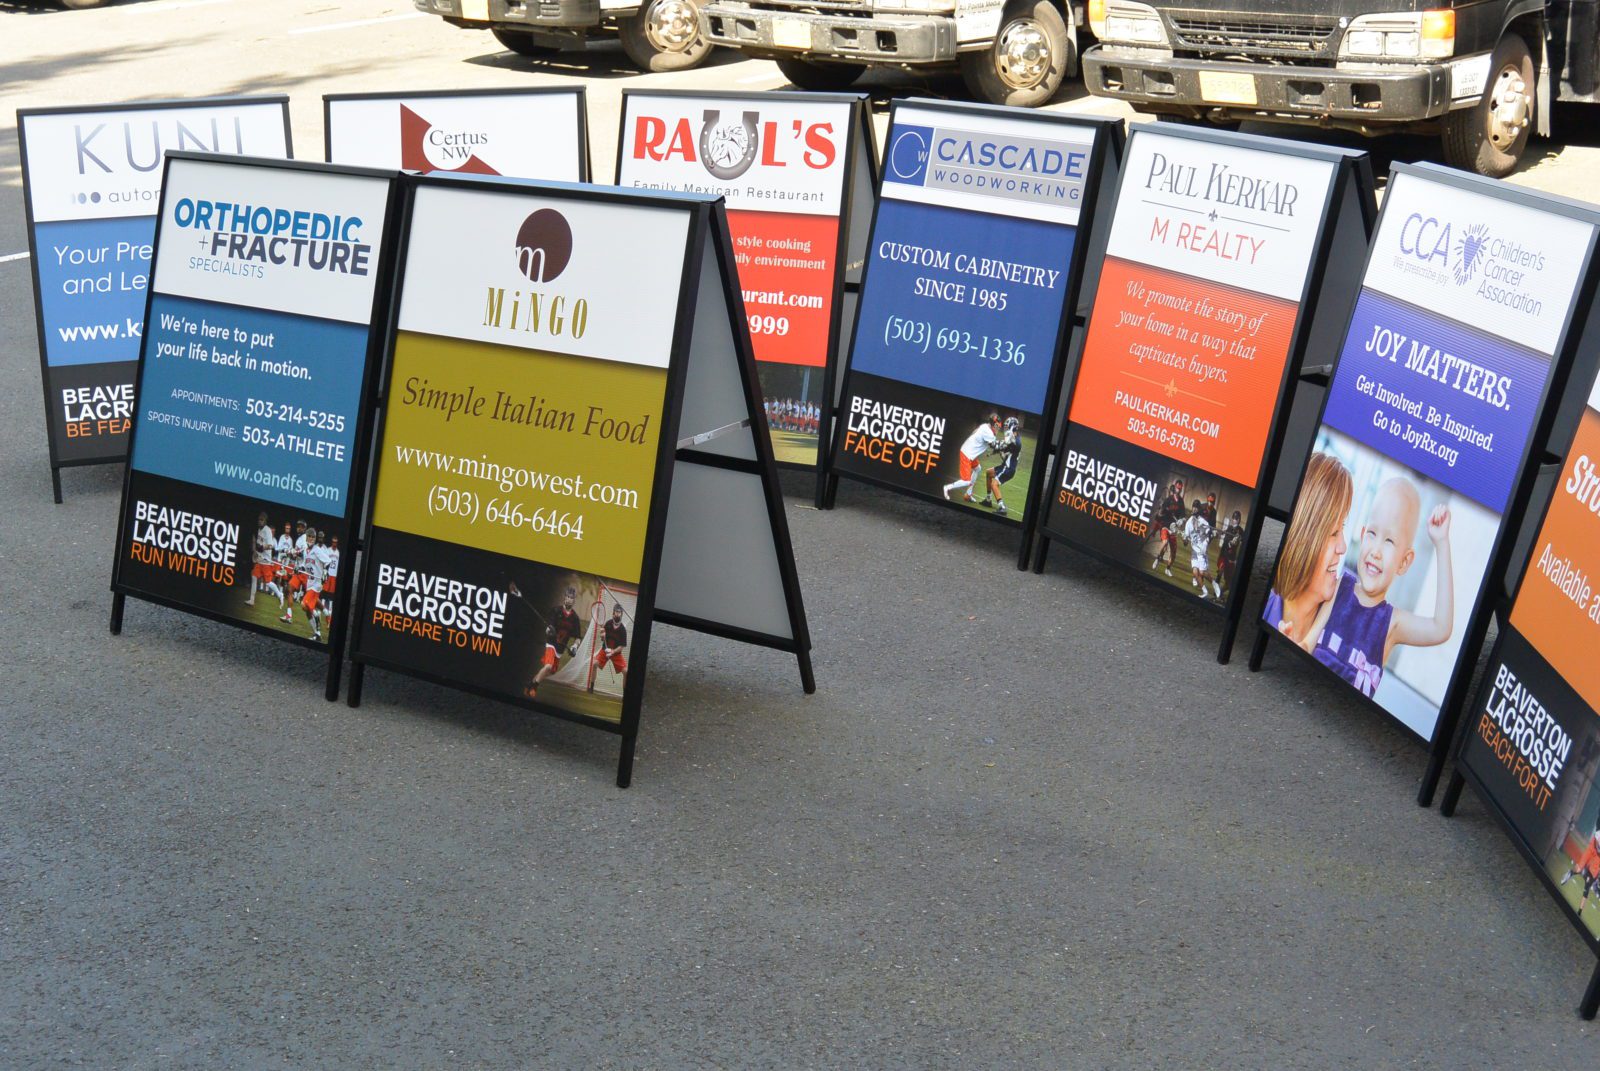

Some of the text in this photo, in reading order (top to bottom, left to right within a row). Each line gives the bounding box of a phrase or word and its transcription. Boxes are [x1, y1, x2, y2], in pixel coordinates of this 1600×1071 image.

[74, 116, 243, 174] KUNI
[430, 130, 487, 146] Certus
[442, 147, 471, 160] NW
[938, 138, 1085, 179] CASCADE
[684, 184, 739, 196] Mexican
[747, 187, 823, 202] Restaurant
[934, 170, 1079, 199] WOODWORKING
[174, 198, 363, 242] ORTHOPEDIC
[1151, 217, 1266, 264] M REALTY
[1400, 212, 1451, 267] CCA
[54, 242, 153, 265] Your Pre
[737, 236, 762, 248] style
[766, 239, 811, 253] cooking
[755, 255, 825, 270] environment
[879, 241, 1060, 288] CUSTOM CABINETRY
[1491, 238, 1545, 271] Children's
[63, 272, 150, 294] and Le
[189, 257, 264, 278] SPECIALISTS
[1484, 259, 1525, 287] Cancer
[914, 278, 1007, 310] SINCE 1985
[1127, 280, 1268, 336] We promote the story of
[1476, 279, 1542, 316] Association
[59, 318, 143, 342] www.k
[161, 313, 274, 349] We're here to put
[747, 314, 789, 336] 999
[885, 315, 1026, 365] (503) 693-1336
[1116, 311, 1256, 360] your home in a way that
[156, 343, 311, 380] your life back in motion.
[1130, 342, 1227, 383] captivates buyers.
[1365, 325, 1511, 410] JOY MATTERS.
[62, 384, 134, 404] BEAVE
[64, 401, 134, 422] LACR
[171, 389, 345, 432] APPOINTMENTS: 503-214-5255
[403, 377, 650, 445] Simple Italian Food
[851, 396, 946, 434] BEAVERTON
[1115, 391, 1220, 438] PAULKERKAR.COM
[1356, 375, 1494, 452] Get Involved. Be Inspired.
[66, 422, 91, 437] BE
[148, 411, 345, 462] SPORTS INJURY LINE: 503-ATHLETE
[848, 413, 942, 454] LACROSSE
[1128, 418, 1195, 453] 503-516-5783
[1373, 410, 1459, 467] Go to JoyRx.org
[844, 431, 939, 474] FACE OFF
[214, 461, 339, 501] www.oandfs.com
[395, 446, 638, 508] www.mingowest.com
[1062, 468, 1153, 523] LACROSSE
[1067, 450, 1157, 501] BEAVERTON
[1566, 455, 1600, 517] Stro
[135, 501, 239, 544] BEAVERTON
[429, 485, 583, 541] (503) 646-6464
[1059, 490, 1147, 538] STICK TOGETHER
[131, 542, 234, 586] RUN WITH US
[133, 521, 237, 566] LACROSSE
[378, 564, 507, 613] BEAVERTON
[1537, 543, 1590, 610] Available
[373, 610, 501, 657] PREPARE TO WIN
[375, 586, 504, 638] LACROSSE
[1495, 663, 1572, 762] BEAVERTON
[1486, 687, 1563, 790] LACROSSE
[1478, 714, 1551, 811] REACH FOR IT
